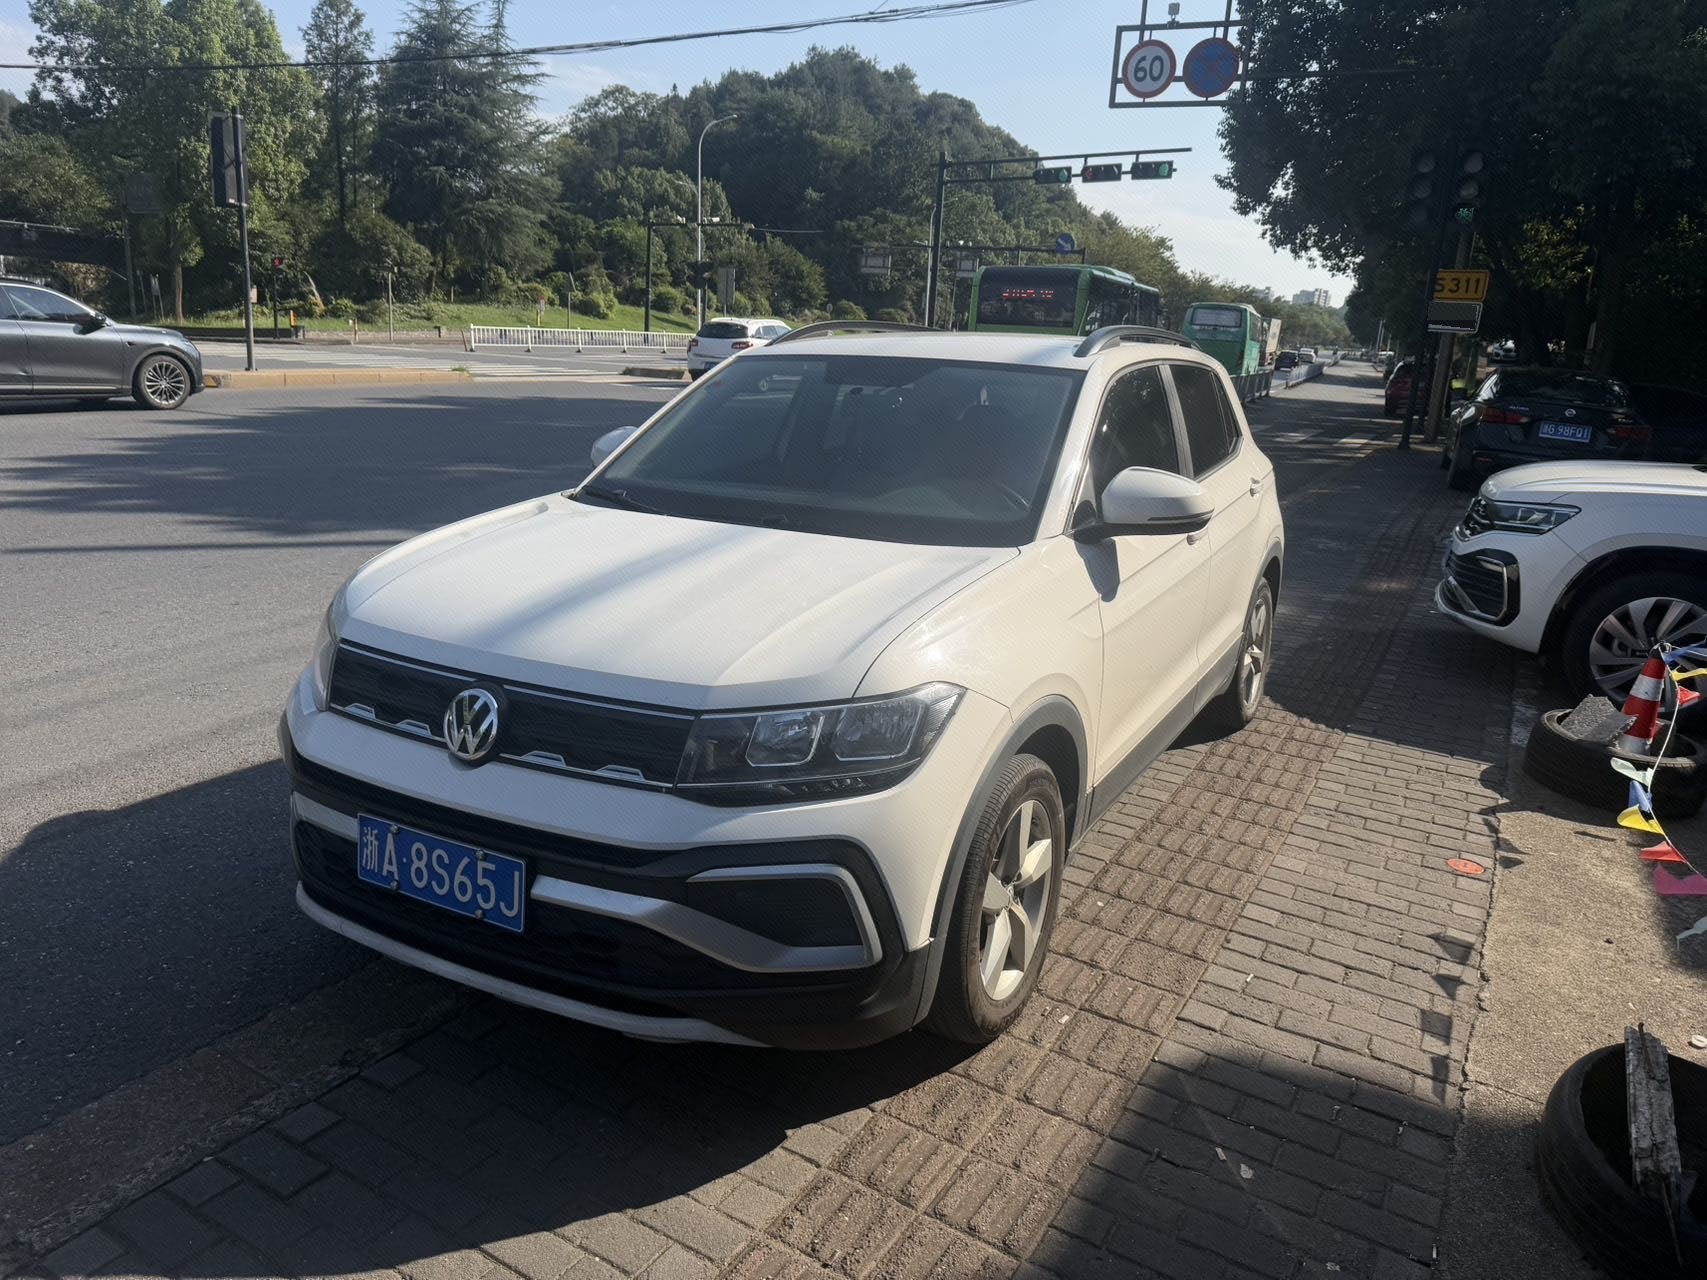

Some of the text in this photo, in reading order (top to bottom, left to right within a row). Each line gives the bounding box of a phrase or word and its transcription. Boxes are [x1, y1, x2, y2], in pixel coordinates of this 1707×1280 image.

[1133, 55, 1165, 82] 60
[1436, 278, 1481, 294] S311
[362, 827, 520, 917] 浙A·8S65J
